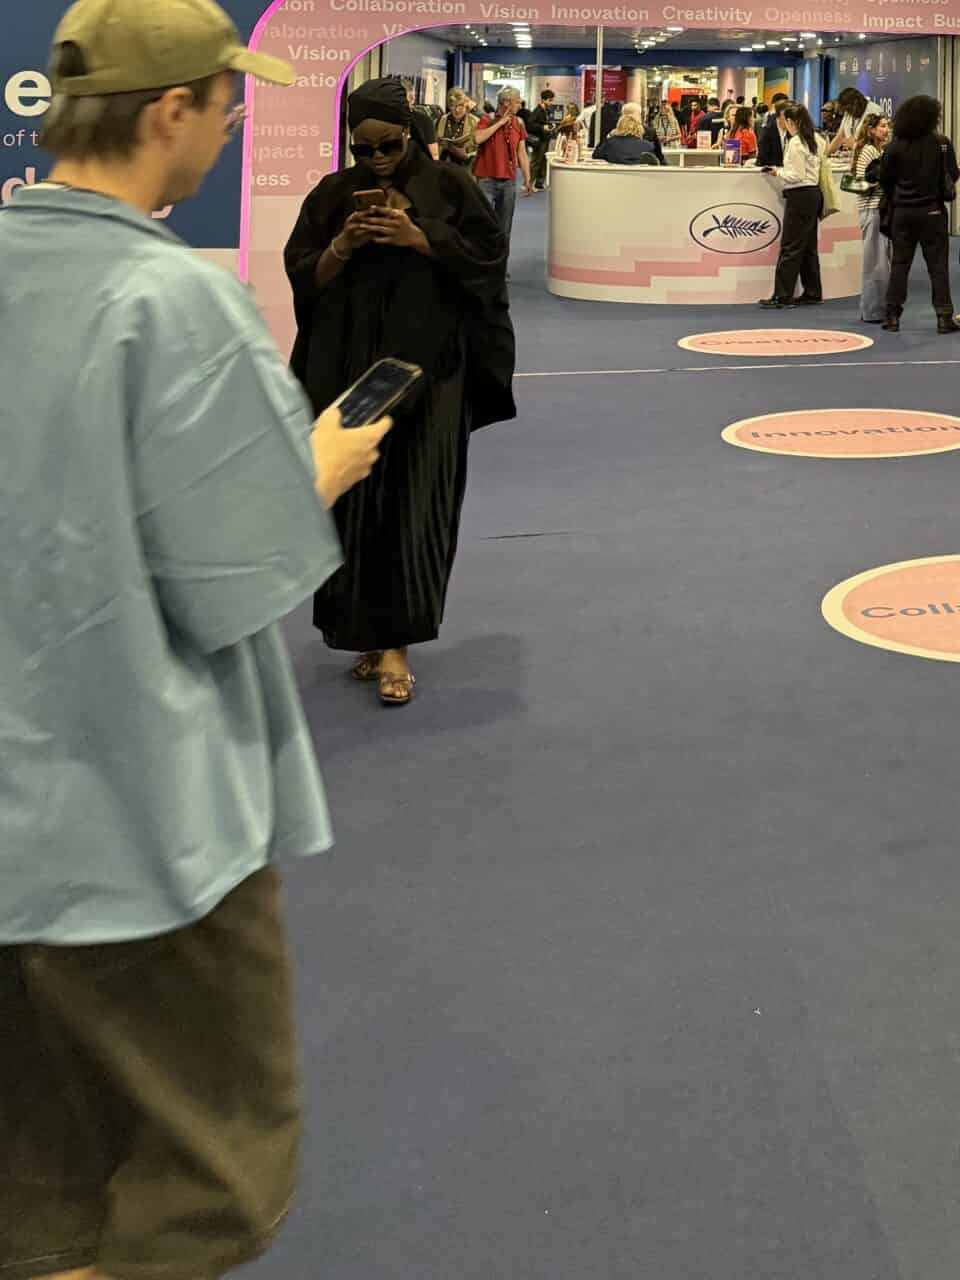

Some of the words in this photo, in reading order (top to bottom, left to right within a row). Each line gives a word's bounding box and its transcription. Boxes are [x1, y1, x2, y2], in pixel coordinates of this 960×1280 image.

[479, 3, 540, 20] Vision
[551, 5, 649, 22] Innovation
[661, 6, 753, 24] Creativity
[764, 7, 852, 24] Openness
[863, 13, 923, 30] Impact
[288, 45, 351, 62] Vision
[3, 129, 26, 146] of
